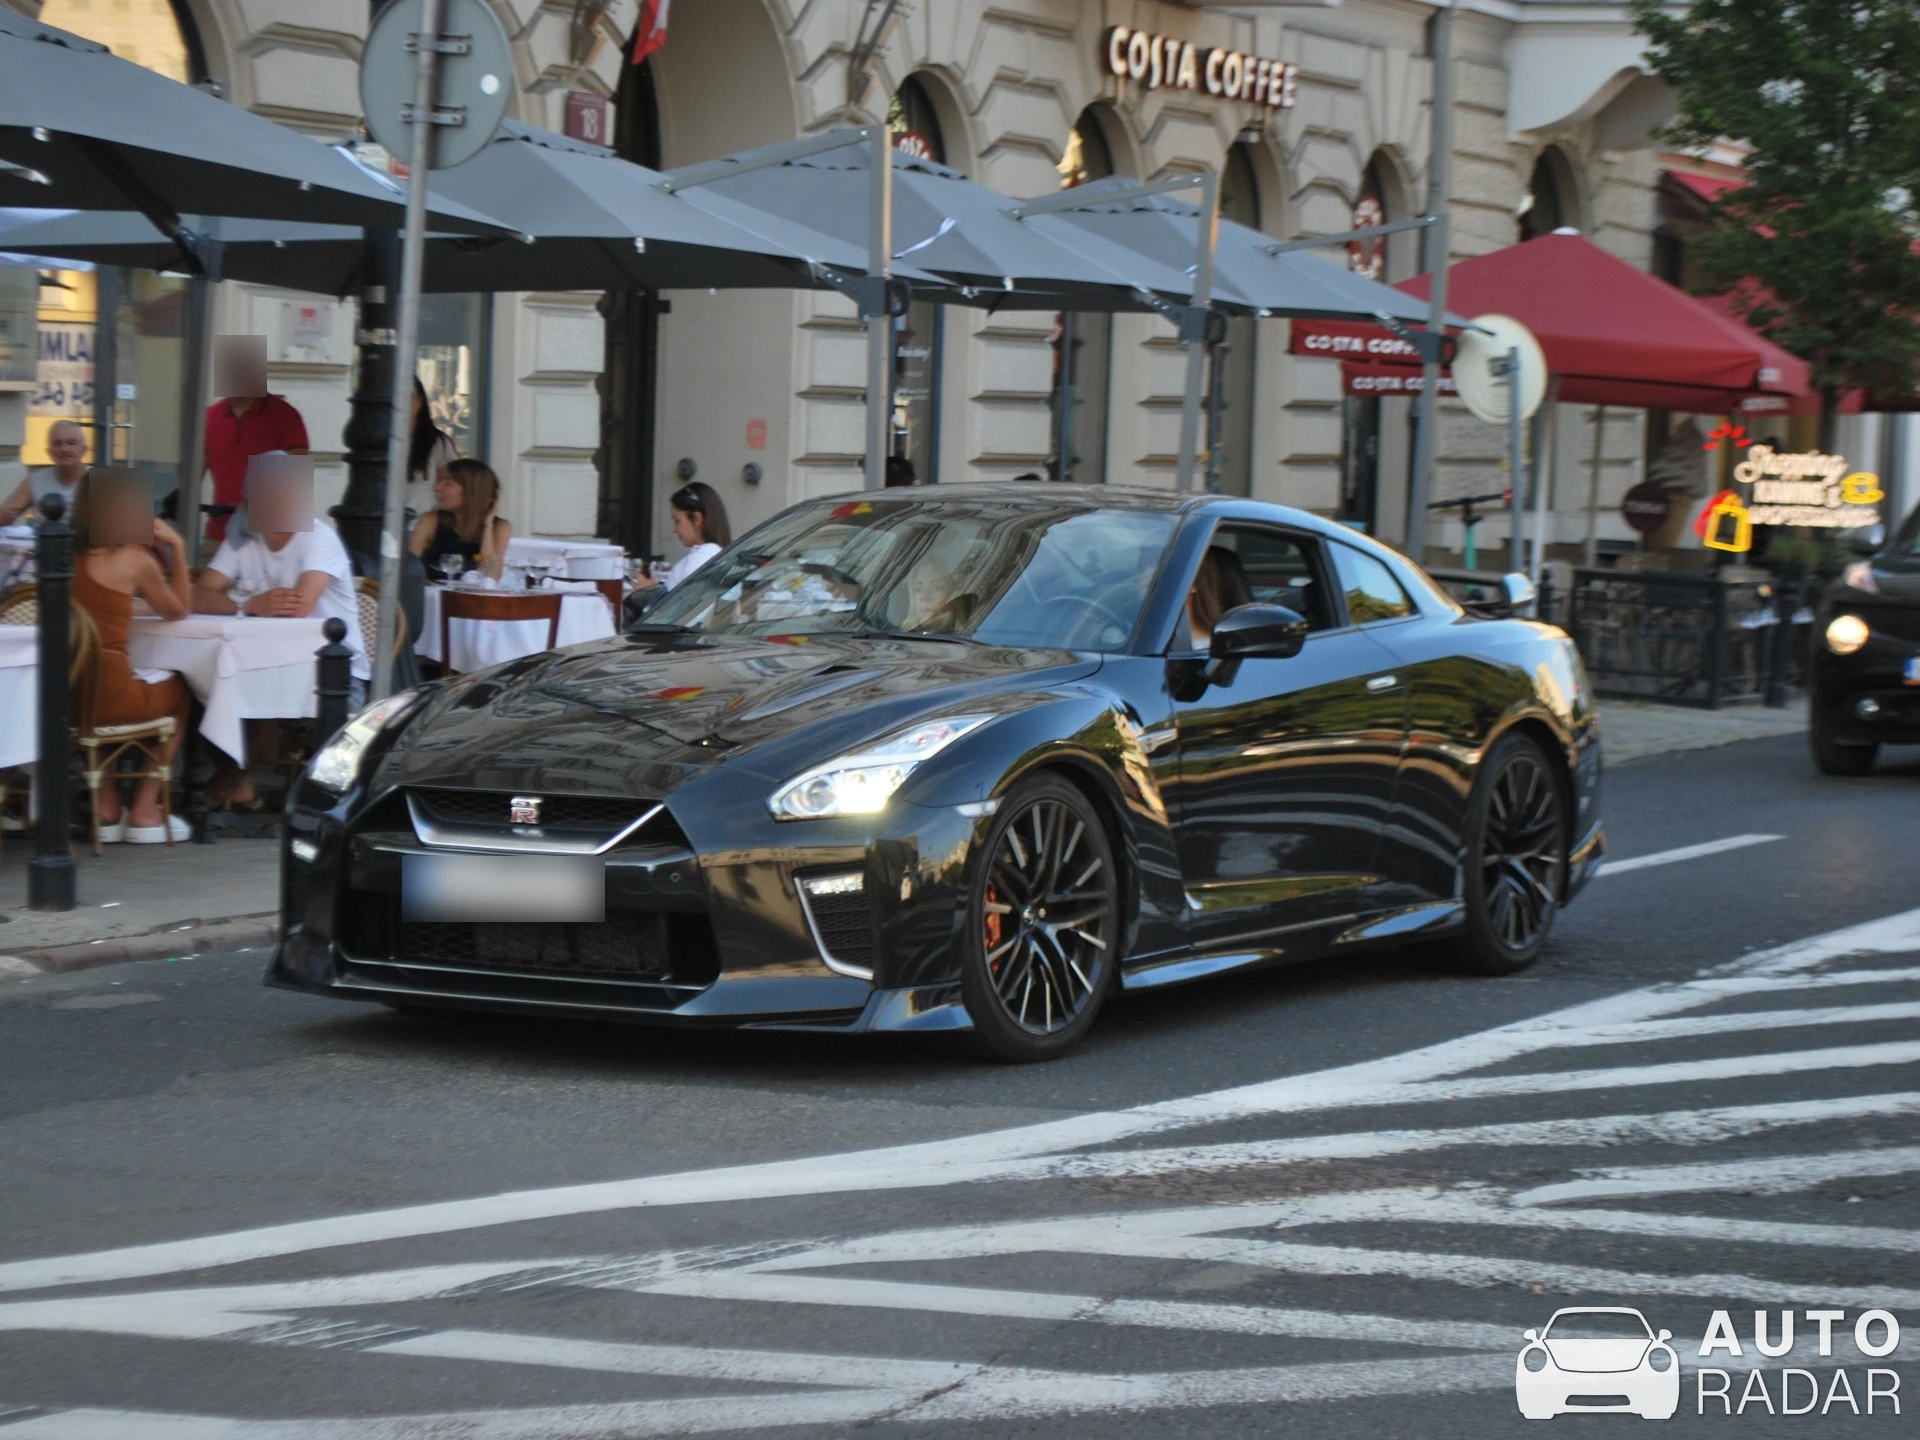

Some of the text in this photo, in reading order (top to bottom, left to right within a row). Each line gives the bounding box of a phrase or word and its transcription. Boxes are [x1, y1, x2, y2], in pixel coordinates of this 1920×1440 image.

[1109, 25, 1297, 108] COSTA COFFEE
[580, 108, 598, 140] 18
[1304, 334, 1363, 352] COSTA
[1352, 376, 1401, 392] COSTA
